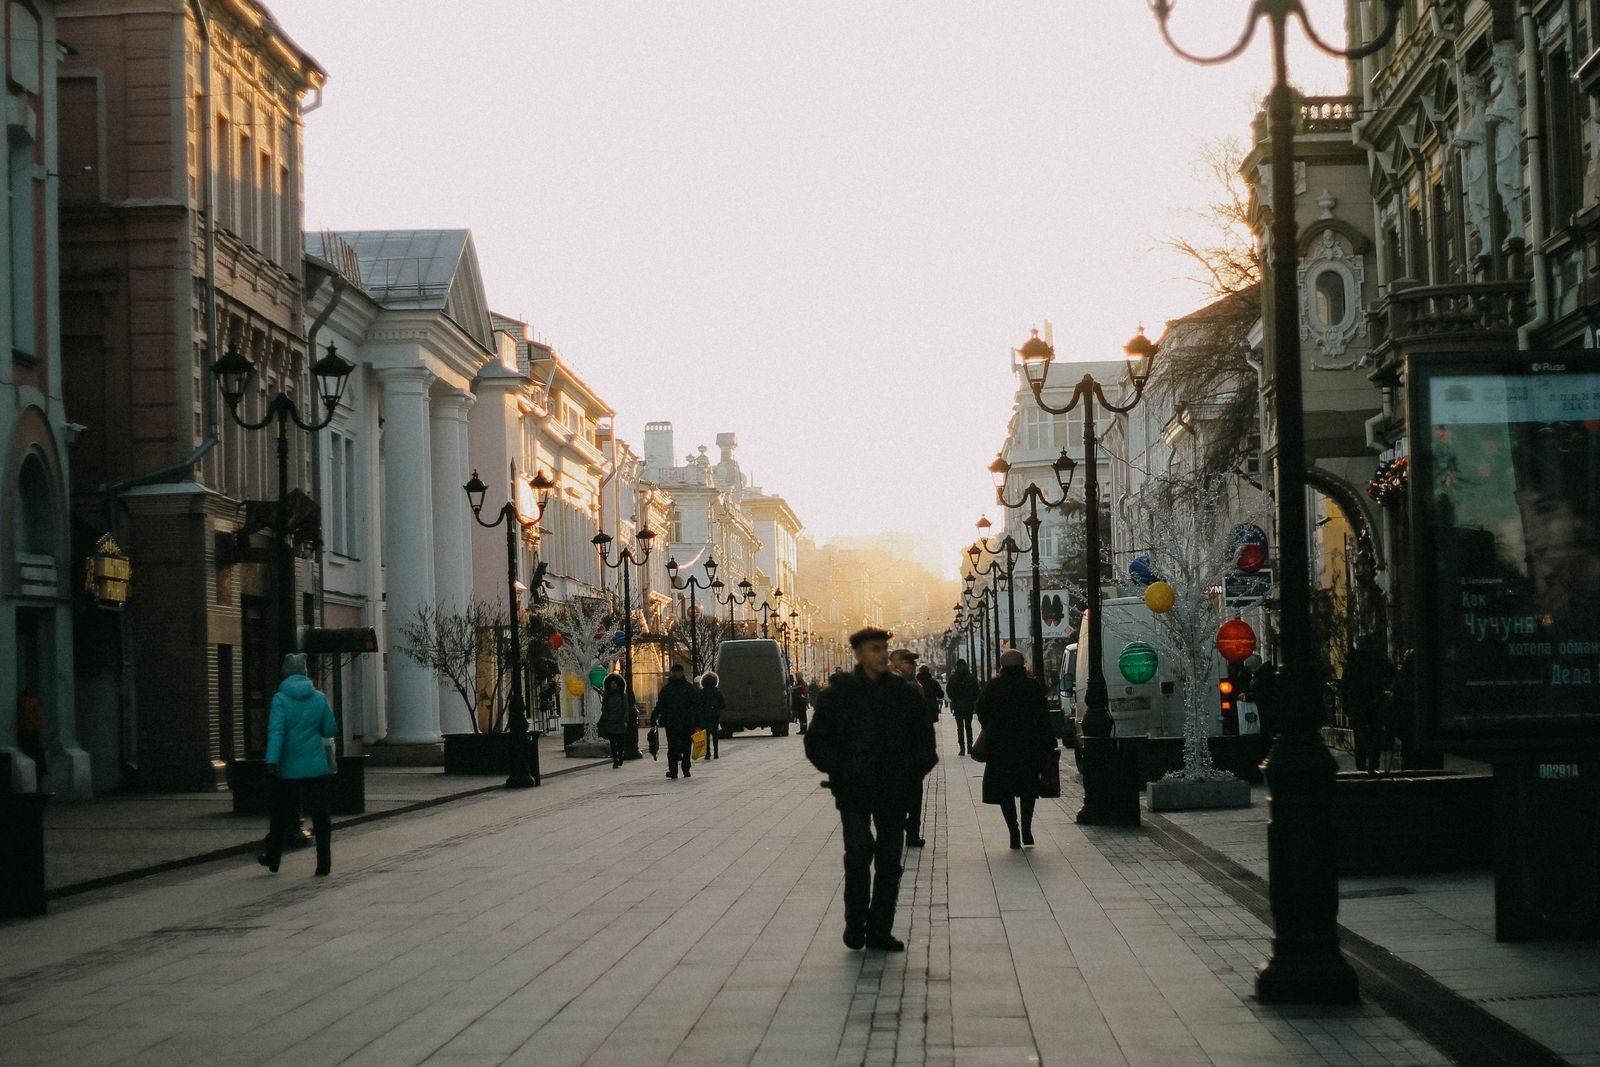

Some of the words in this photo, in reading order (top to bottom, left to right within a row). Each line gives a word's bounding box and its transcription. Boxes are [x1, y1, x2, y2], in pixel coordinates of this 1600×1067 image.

[1462, 591, 1487, 608] Как
[1463, 613, 1534, 641] Чучуня
[1508, 642, 1552, 656] хотела
[1551, 664, 1592, 686] Деда
